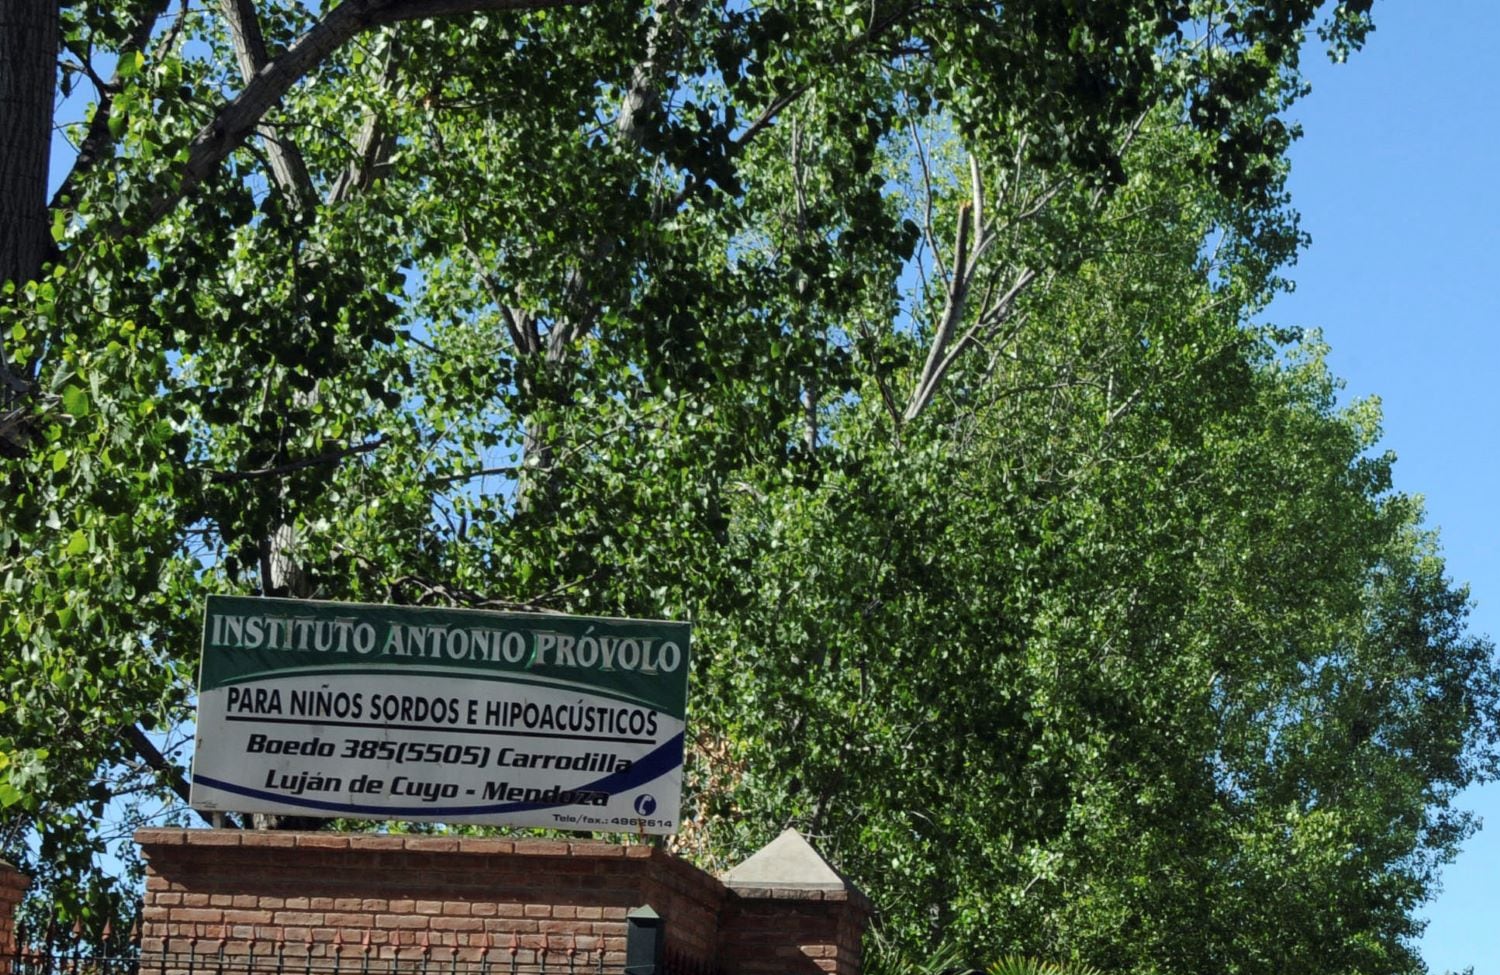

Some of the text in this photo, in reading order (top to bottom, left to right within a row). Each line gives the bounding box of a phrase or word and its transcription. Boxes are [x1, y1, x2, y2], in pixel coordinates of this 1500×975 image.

[212, 614, 681, 672] INSTITUTO ANTONIO PRÓVOLO
[226, 684, 658, 736] PARA NIÑOS SORDOS E HIPOACÚSTICOS
[246, 734, 632, 774] Boedo 385(5505) Carrodilla
[264, 769, 342, 795] Luján
[348, 774, 384, 795] de
[390, 776, 459, 802] Cuyo
[482, 781, 610, 808] Mendoza
